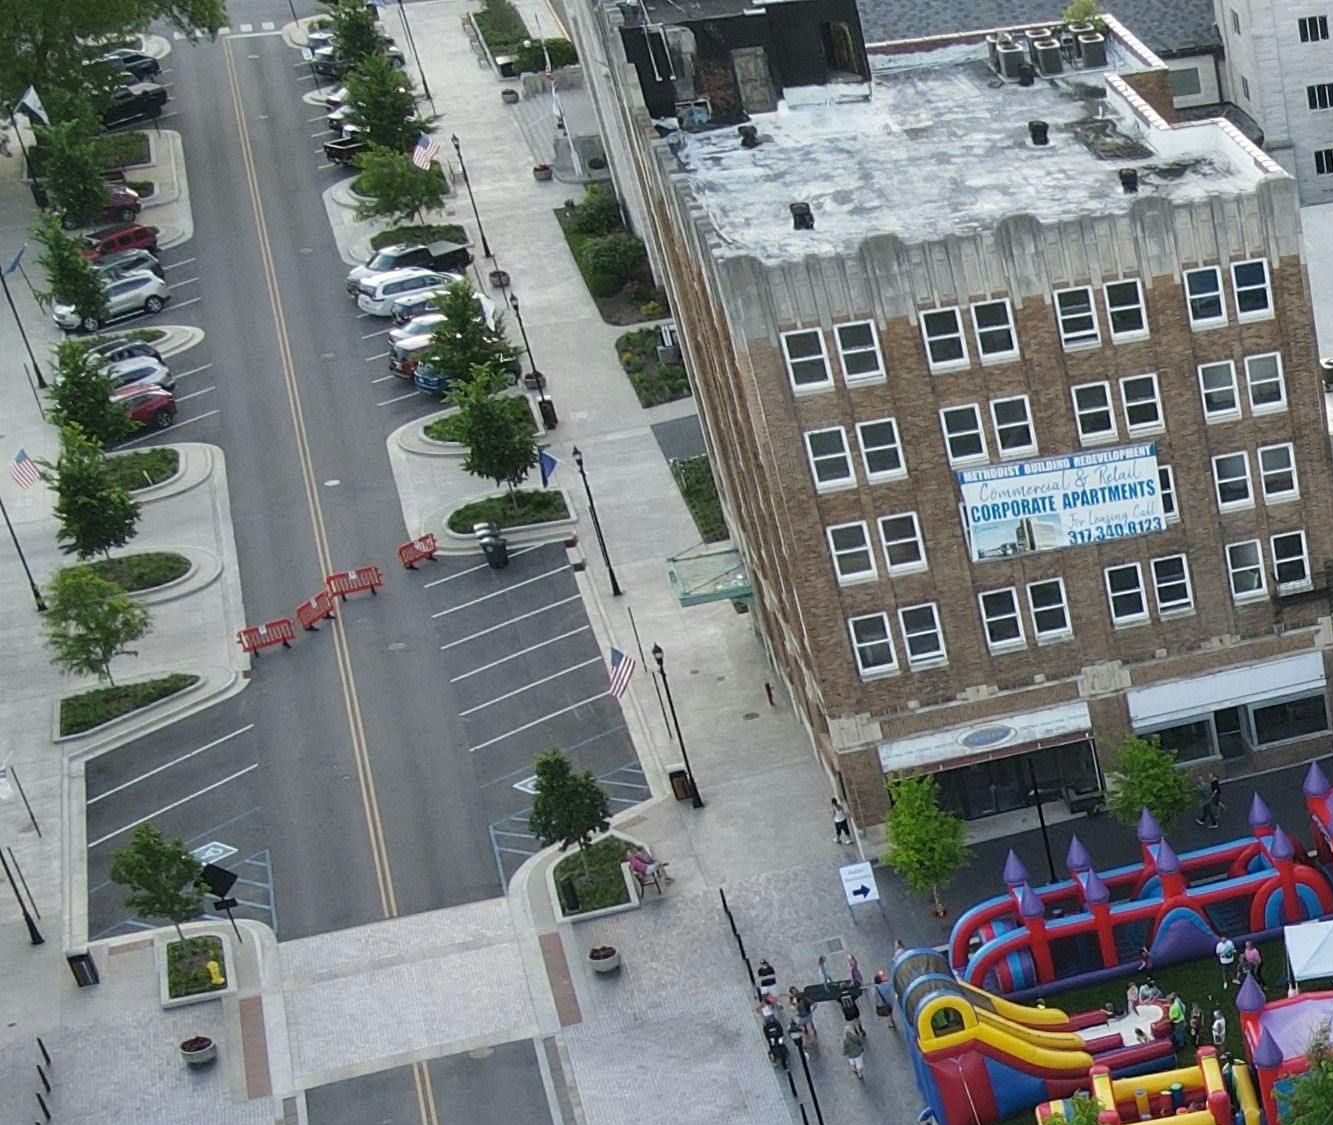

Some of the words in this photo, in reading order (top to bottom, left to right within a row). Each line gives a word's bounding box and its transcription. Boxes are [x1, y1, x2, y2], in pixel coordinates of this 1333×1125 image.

[971, 495, 1057, 523] CORPORATE
[1062, 479, 1156, 510] APARTMENTS
[980, 471, 1069, 502] Commercial
[1075, 469, 1088, 488] &
[1095, 461, 1140, 485] Retail
[1070, 513, 1083, 527] For
[1089, 508, 1128, 527] Leasing
[1133, 501, 1155, 518] Call
